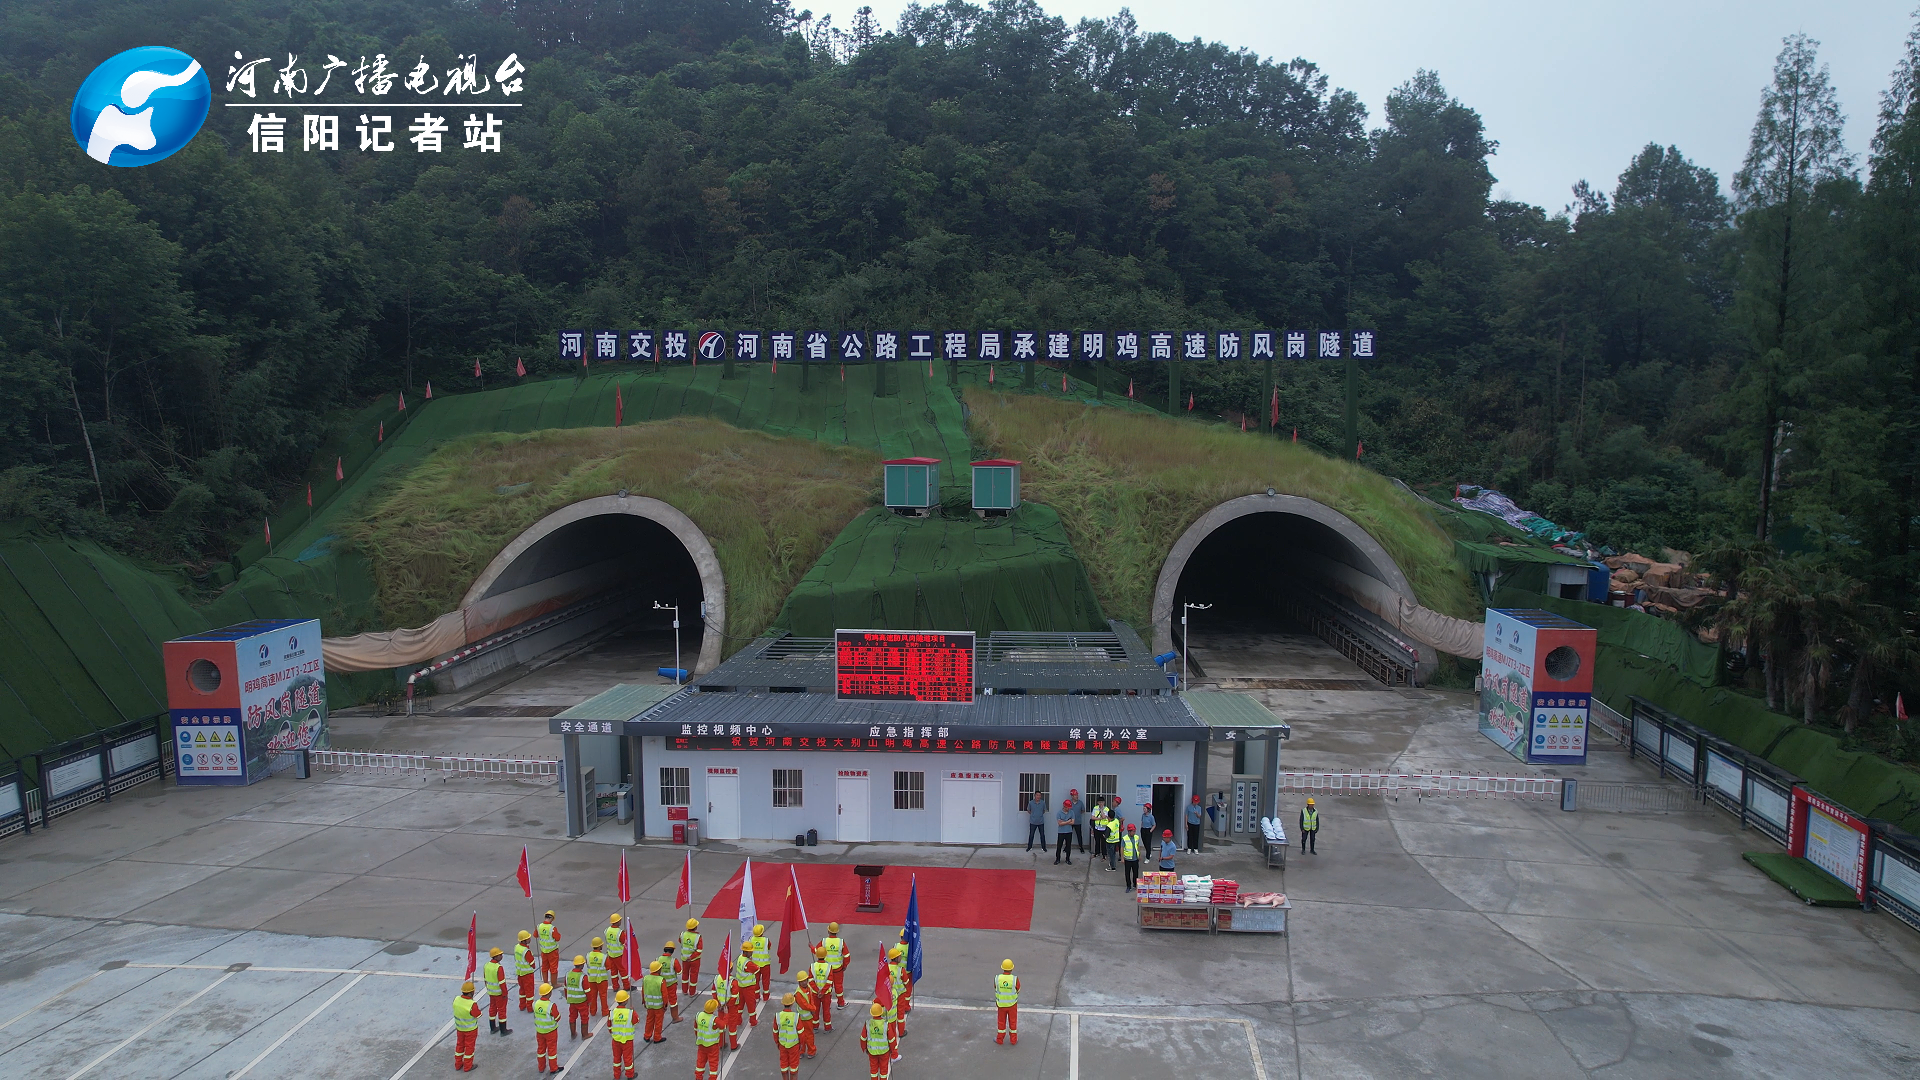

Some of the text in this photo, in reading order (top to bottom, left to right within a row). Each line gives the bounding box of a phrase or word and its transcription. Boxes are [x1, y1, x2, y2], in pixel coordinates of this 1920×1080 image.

[561, 331, 1375, 359] 河南交投 河南省公路工程局承建明鸡高速防风岗隧道
[247, 680, 323, 730] 防风岗隧道
[561, 721, 613, 733] 安全通道
[681, 724, 773, 736] 监控视频中心
[869, 726, 950, 738] 应急指挥部
[1069, 728, 1148, 740] 综合办公室
[731, 737, 1138, 750] 祝贺河南交投大别山明鸡高速公路防风岗隧道顺利贯通
